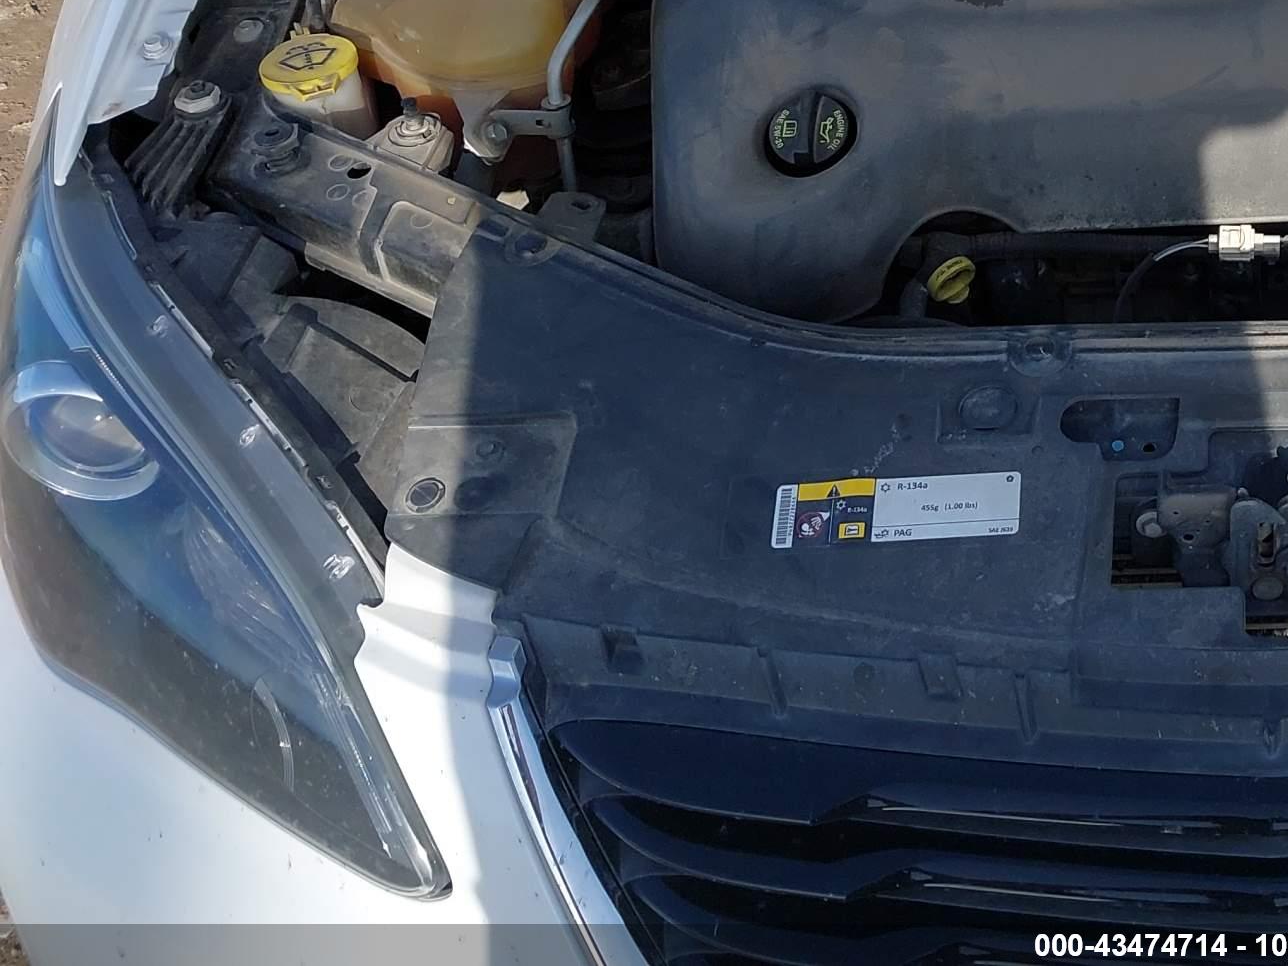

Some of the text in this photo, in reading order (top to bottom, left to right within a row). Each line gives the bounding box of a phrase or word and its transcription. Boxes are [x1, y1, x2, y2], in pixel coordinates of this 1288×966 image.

[774, 109, 790, 149] SAE 5W-20
[826, 109, 845, 151] ENGINE OIL
[897, 482, 928, 491] R-134a
[920, 504, 939, 512] 455g
[944, 502, 964, 511] (1.00
[894, 528, 913, 537] PAG
